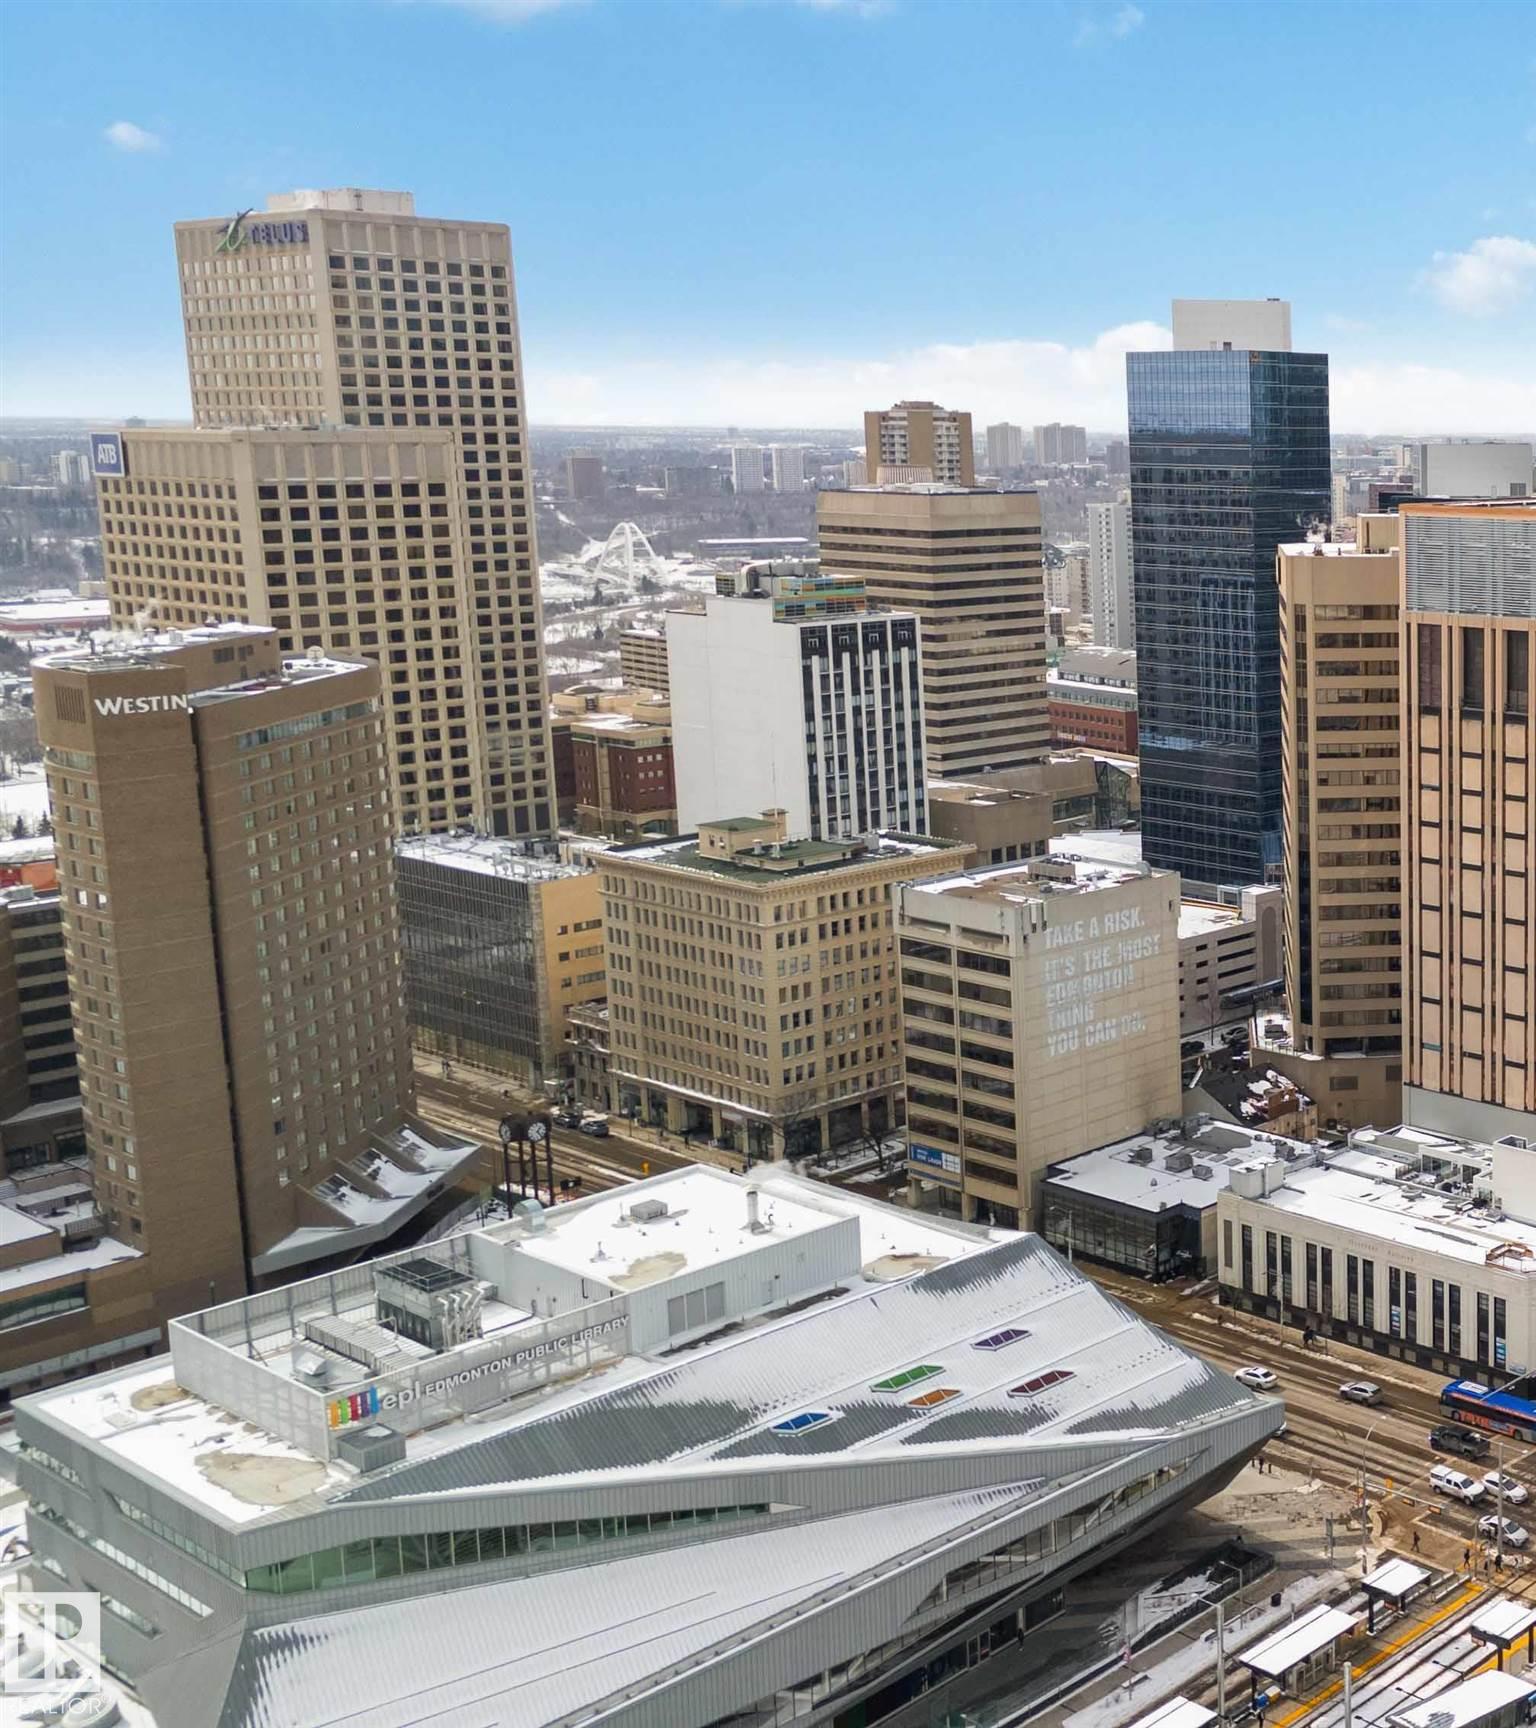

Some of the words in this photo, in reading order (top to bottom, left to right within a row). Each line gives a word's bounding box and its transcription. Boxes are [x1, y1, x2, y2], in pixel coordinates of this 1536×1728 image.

[98, 443, 117, 465] ATB
[94, 694, 188, 716] WESTIN
[1044, 920, 1085, 949] TAKE
[1089, 916, 1100, 939] A
[1104, 907, 1145, 935] RISK.
[1083, 945, 1112, 972] THE
[1047, 1028, 1079, 1057] YOU
[1085, 1018, 1117, 1047] CAN
[382, 1381, 421, 1416] epl
[425, 1356, 512, 1396] EDMONTON
[516, 1336, 568, 1365] PUBLIC
[571, 1316, 630, 1344] LIBRARY
